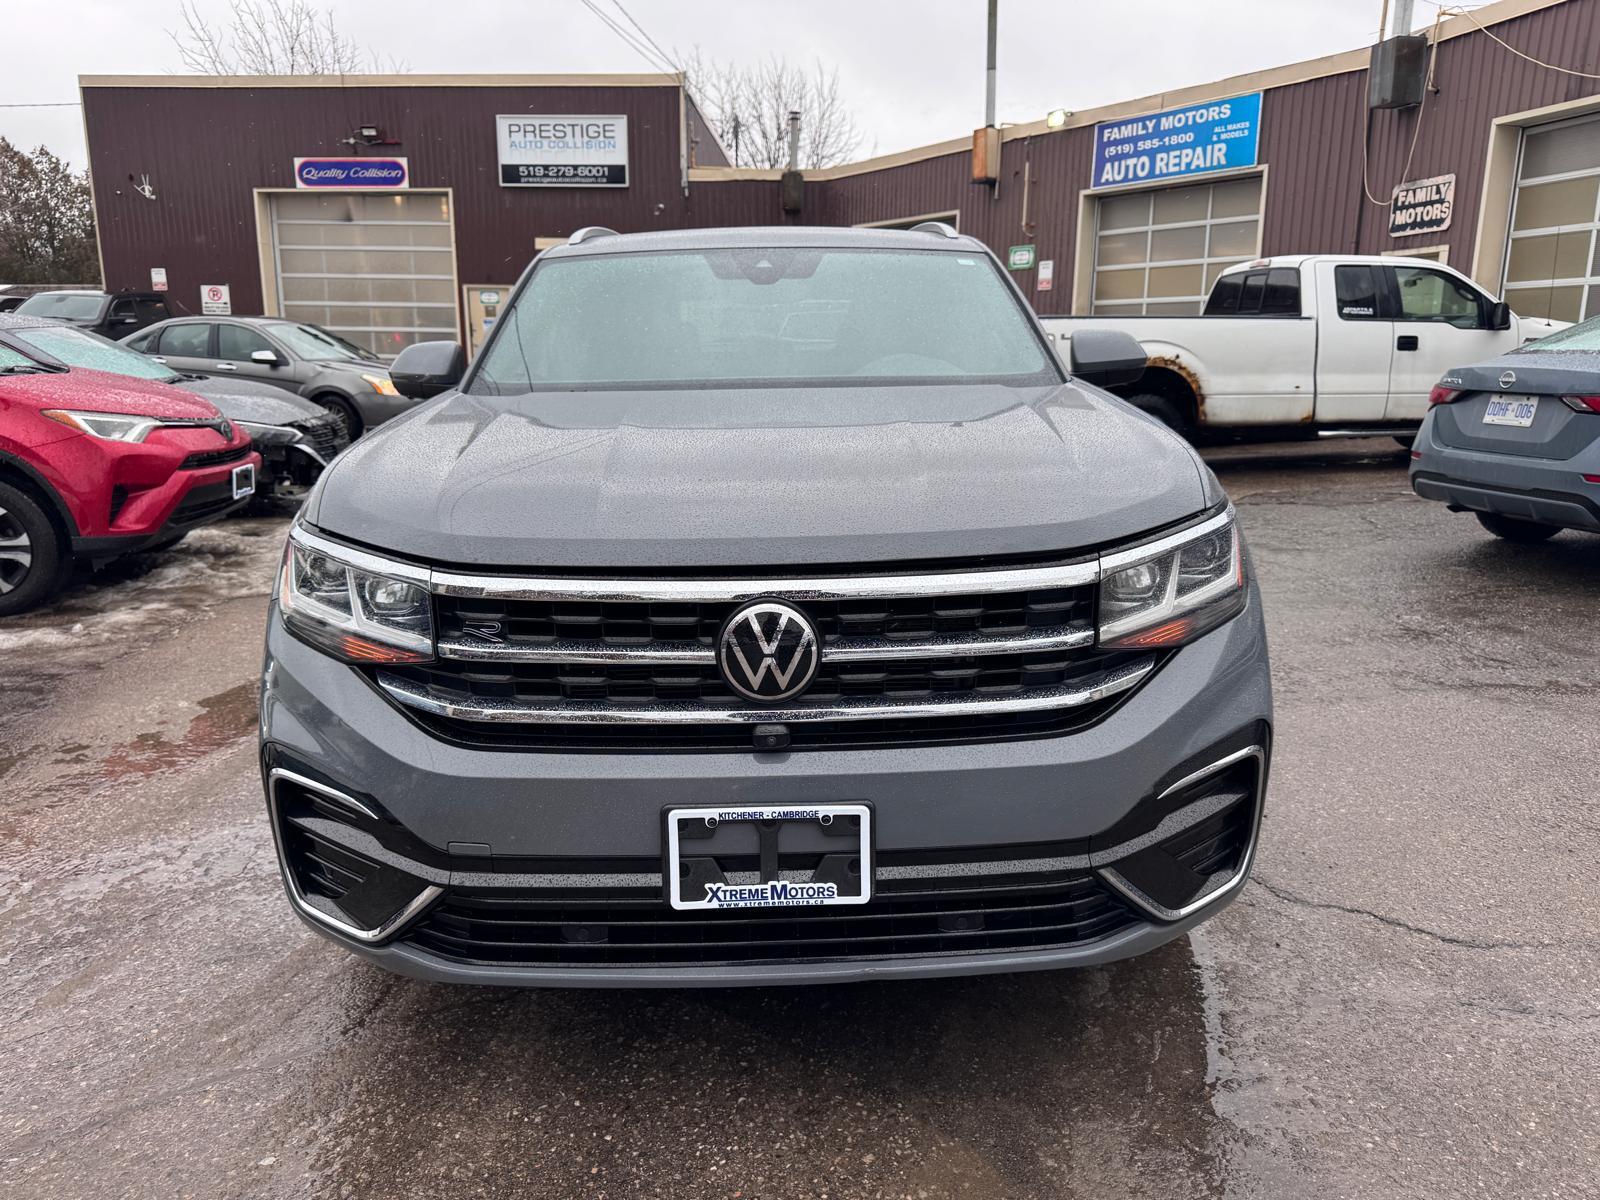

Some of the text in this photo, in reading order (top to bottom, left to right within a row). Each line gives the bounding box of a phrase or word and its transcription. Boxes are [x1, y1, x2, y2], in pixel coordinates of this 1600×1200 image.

[1103, 104, 1231, 142] FAMILY MOTORS
[1214, 121, 1250, 133] ALL MAKES
[508, 123, 616, 139] PRESTIGE
[1220, 130, 1249, 140] MODELS
[510, 140, 617, 149] AUTO COLLISION
[1104, 132, 1194, 158] (519) 585-1800
[1100, 142, 1227, 183] AUTO REPAIR
[302, 167, 402, 179] Quality Collision
[519, 166, 609, 176] 519-279-6001
[1397, 183, 1449, 206] FAMILY
[1395, 202, 1450, 225] MOTORS
[718, 811, 765, 820] KITCHENER
[771, 810, 820, 819] CAMBRIDGE
[718, 899, 825, 908] www.xtrememotors.ca
